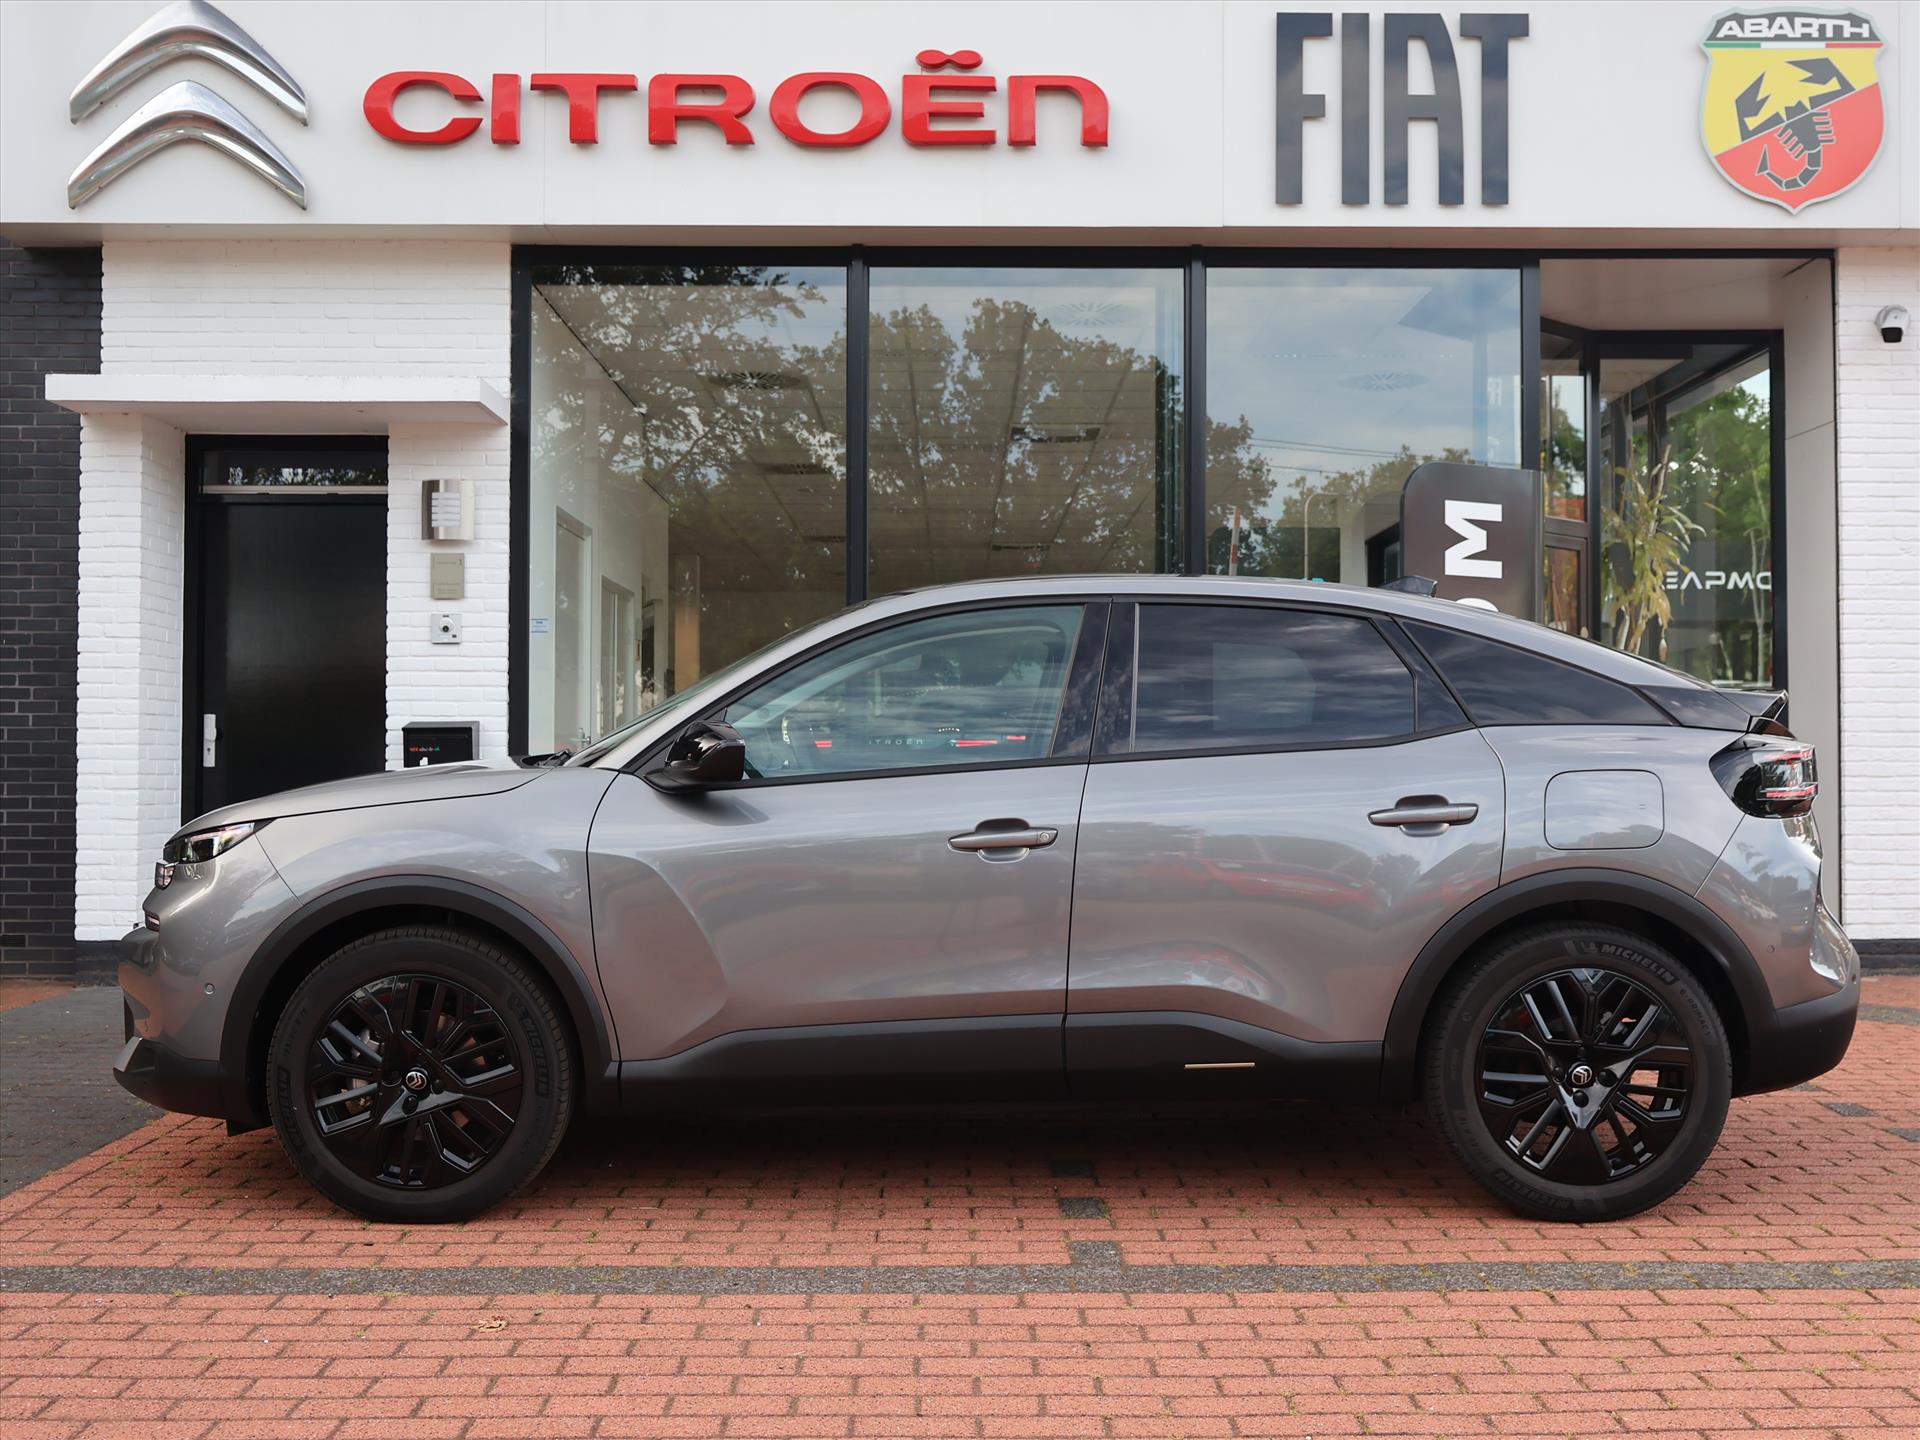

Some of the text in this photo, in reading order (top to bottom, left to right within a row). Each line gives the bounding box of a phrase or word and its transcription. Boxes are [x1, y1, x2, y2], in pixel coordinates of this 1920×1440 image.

[1716, 17, 1870, 38] ABARTH
[363, 49, 1109, 149] CITROËN
[1276, 13, 1530, 206] FIAT
[1444, 499, 1503, 612] M
[1600, 942, 1675, 984] MICHELIN
